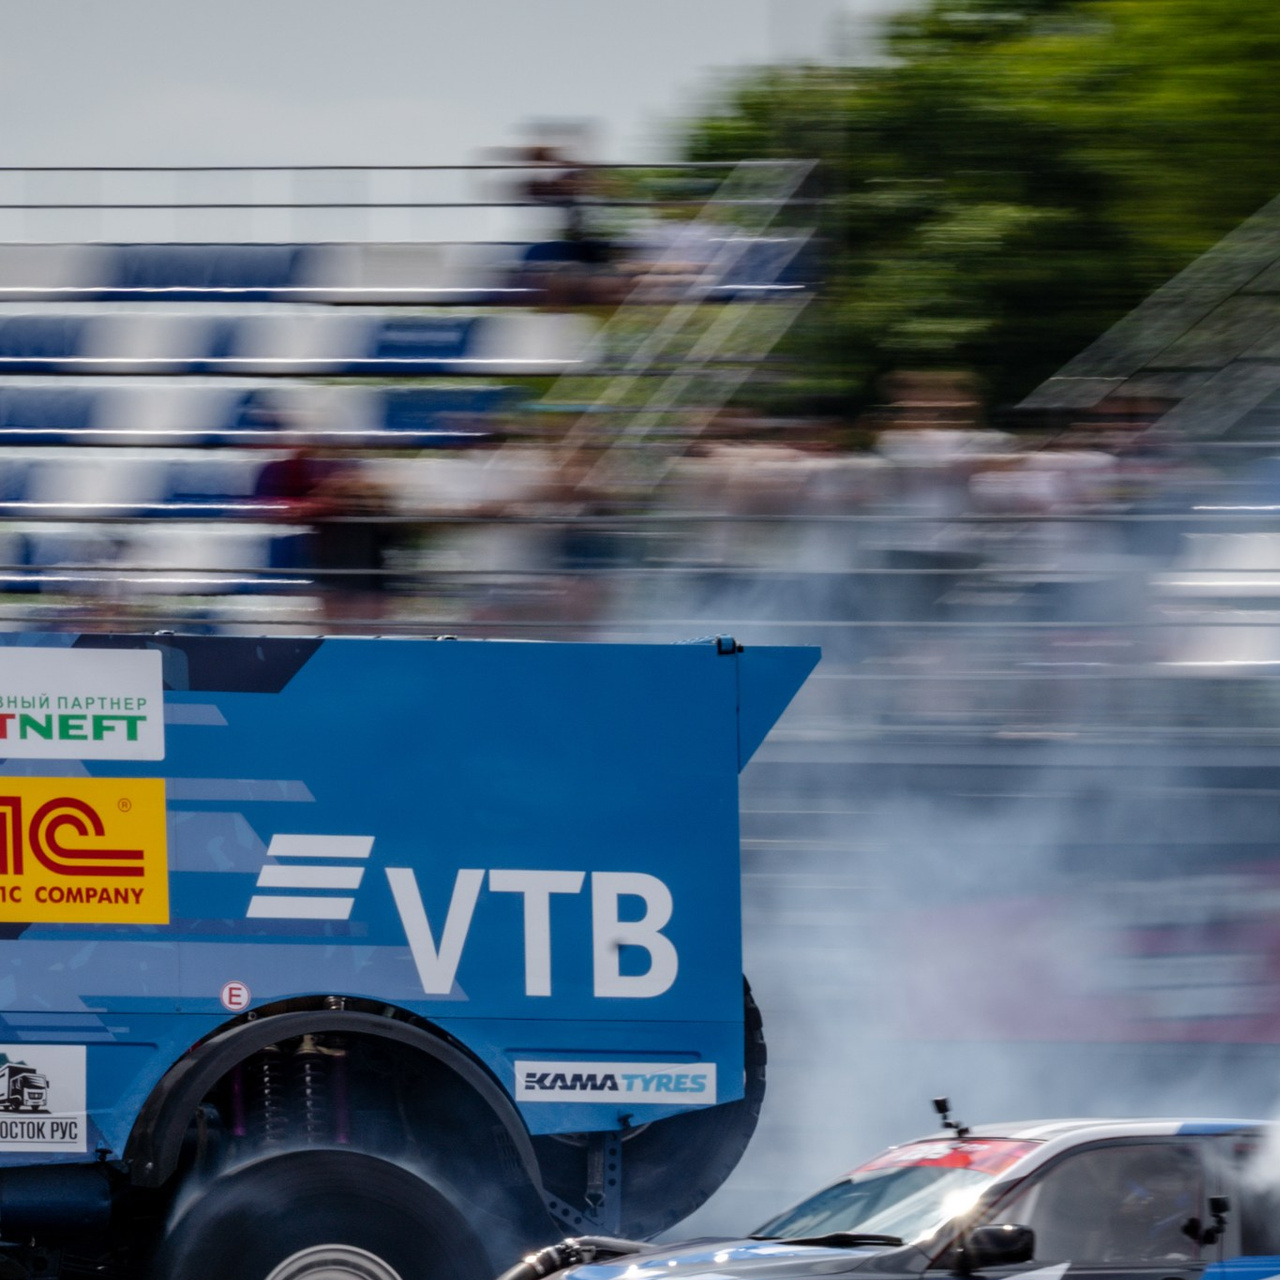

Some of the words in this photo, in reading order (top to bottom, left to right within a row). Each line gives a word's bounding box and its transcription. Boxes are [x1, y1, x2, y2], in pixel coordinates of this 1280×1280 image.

[57, 696, 147, 710] ПАРТНЕР
[0, 886, 22, 903] 1C
[34, 887, 145, 905] COMPANY
[385, 867, 679, 999] VTB
[525, 1072, 619, 1091] KAMA
[621, 1074, 708, 1093] TYRES
[50, 1121, 78, 1140] РУС
